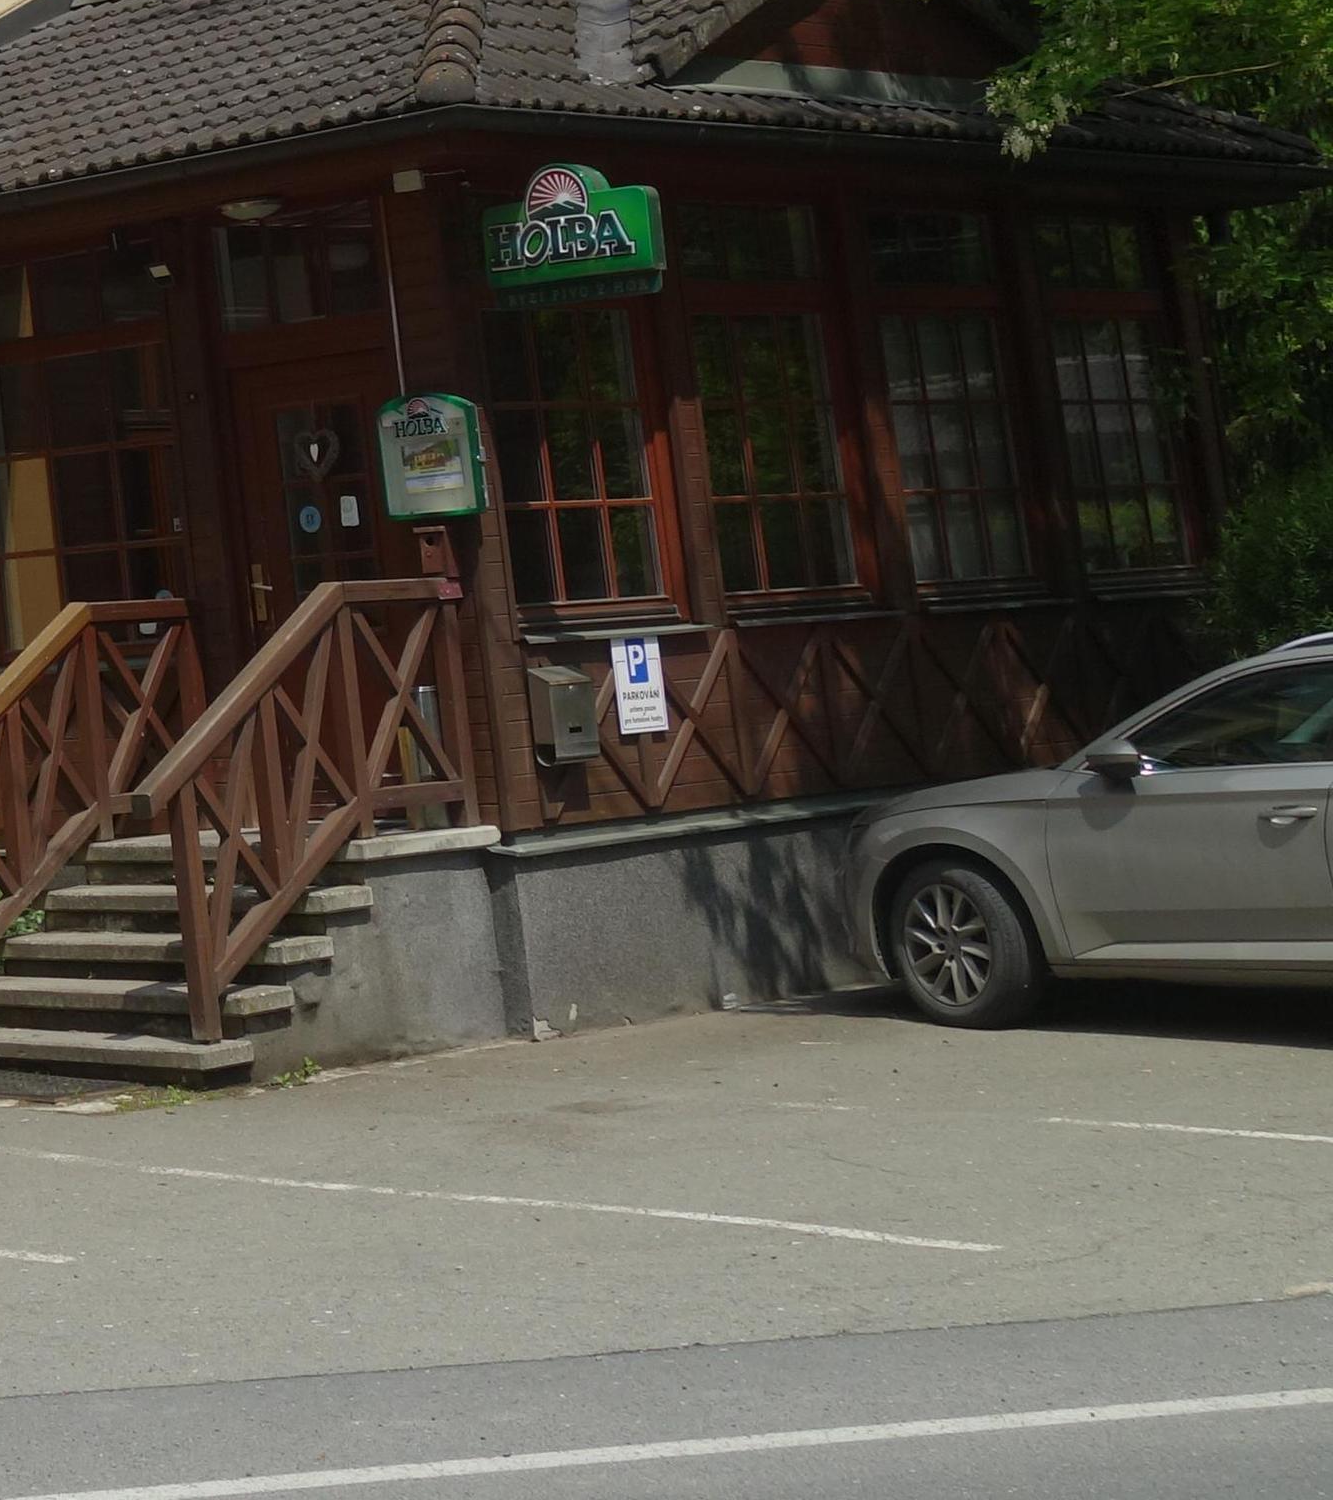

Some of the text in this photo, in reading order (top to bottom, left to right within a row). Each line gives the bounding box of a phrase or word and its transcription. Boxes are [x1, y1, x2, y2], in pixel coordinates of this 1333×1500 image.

[488, 210, 635, 271] HOLBA
[394, 417, 448, 438] HOLBA
[627, 644, 644, 677] P
[622, 686, 660, 700] PARKOVÁNÍ
